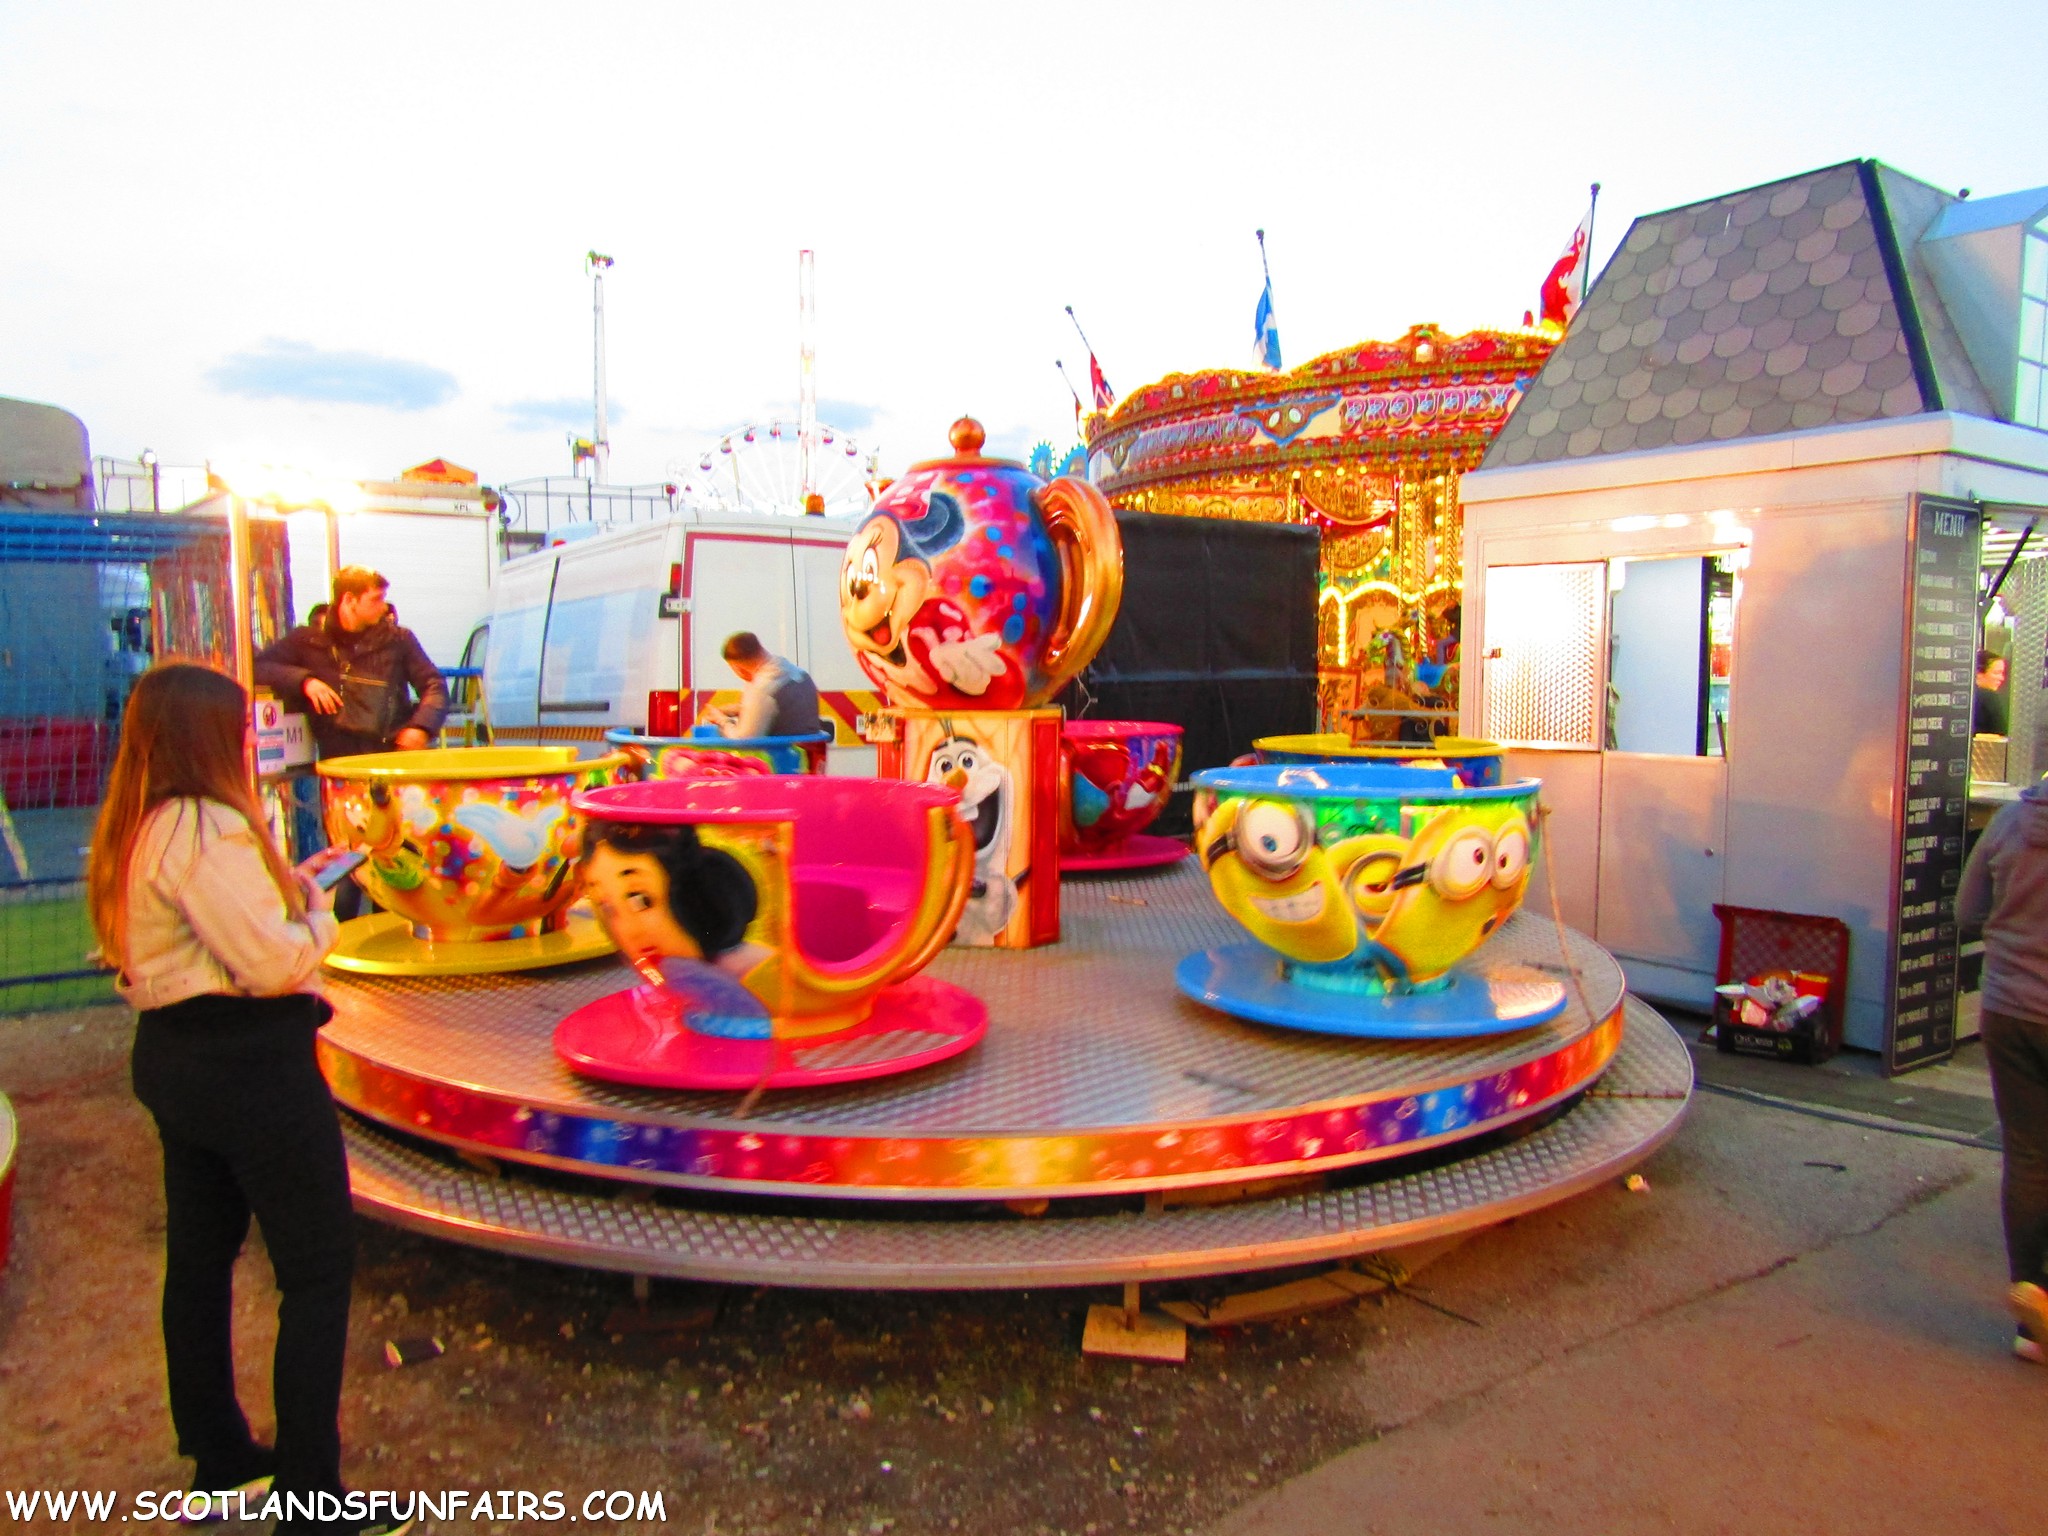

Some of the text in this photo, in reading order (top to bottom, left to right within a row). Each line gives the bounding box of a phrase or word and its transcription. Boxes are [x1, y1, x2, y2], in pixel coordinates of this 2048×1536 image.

[1342, 384, 1513, 430] PROUDLY
[1934, 511, 1965, 537] MENU
[286, 727, 303, 744] M1
